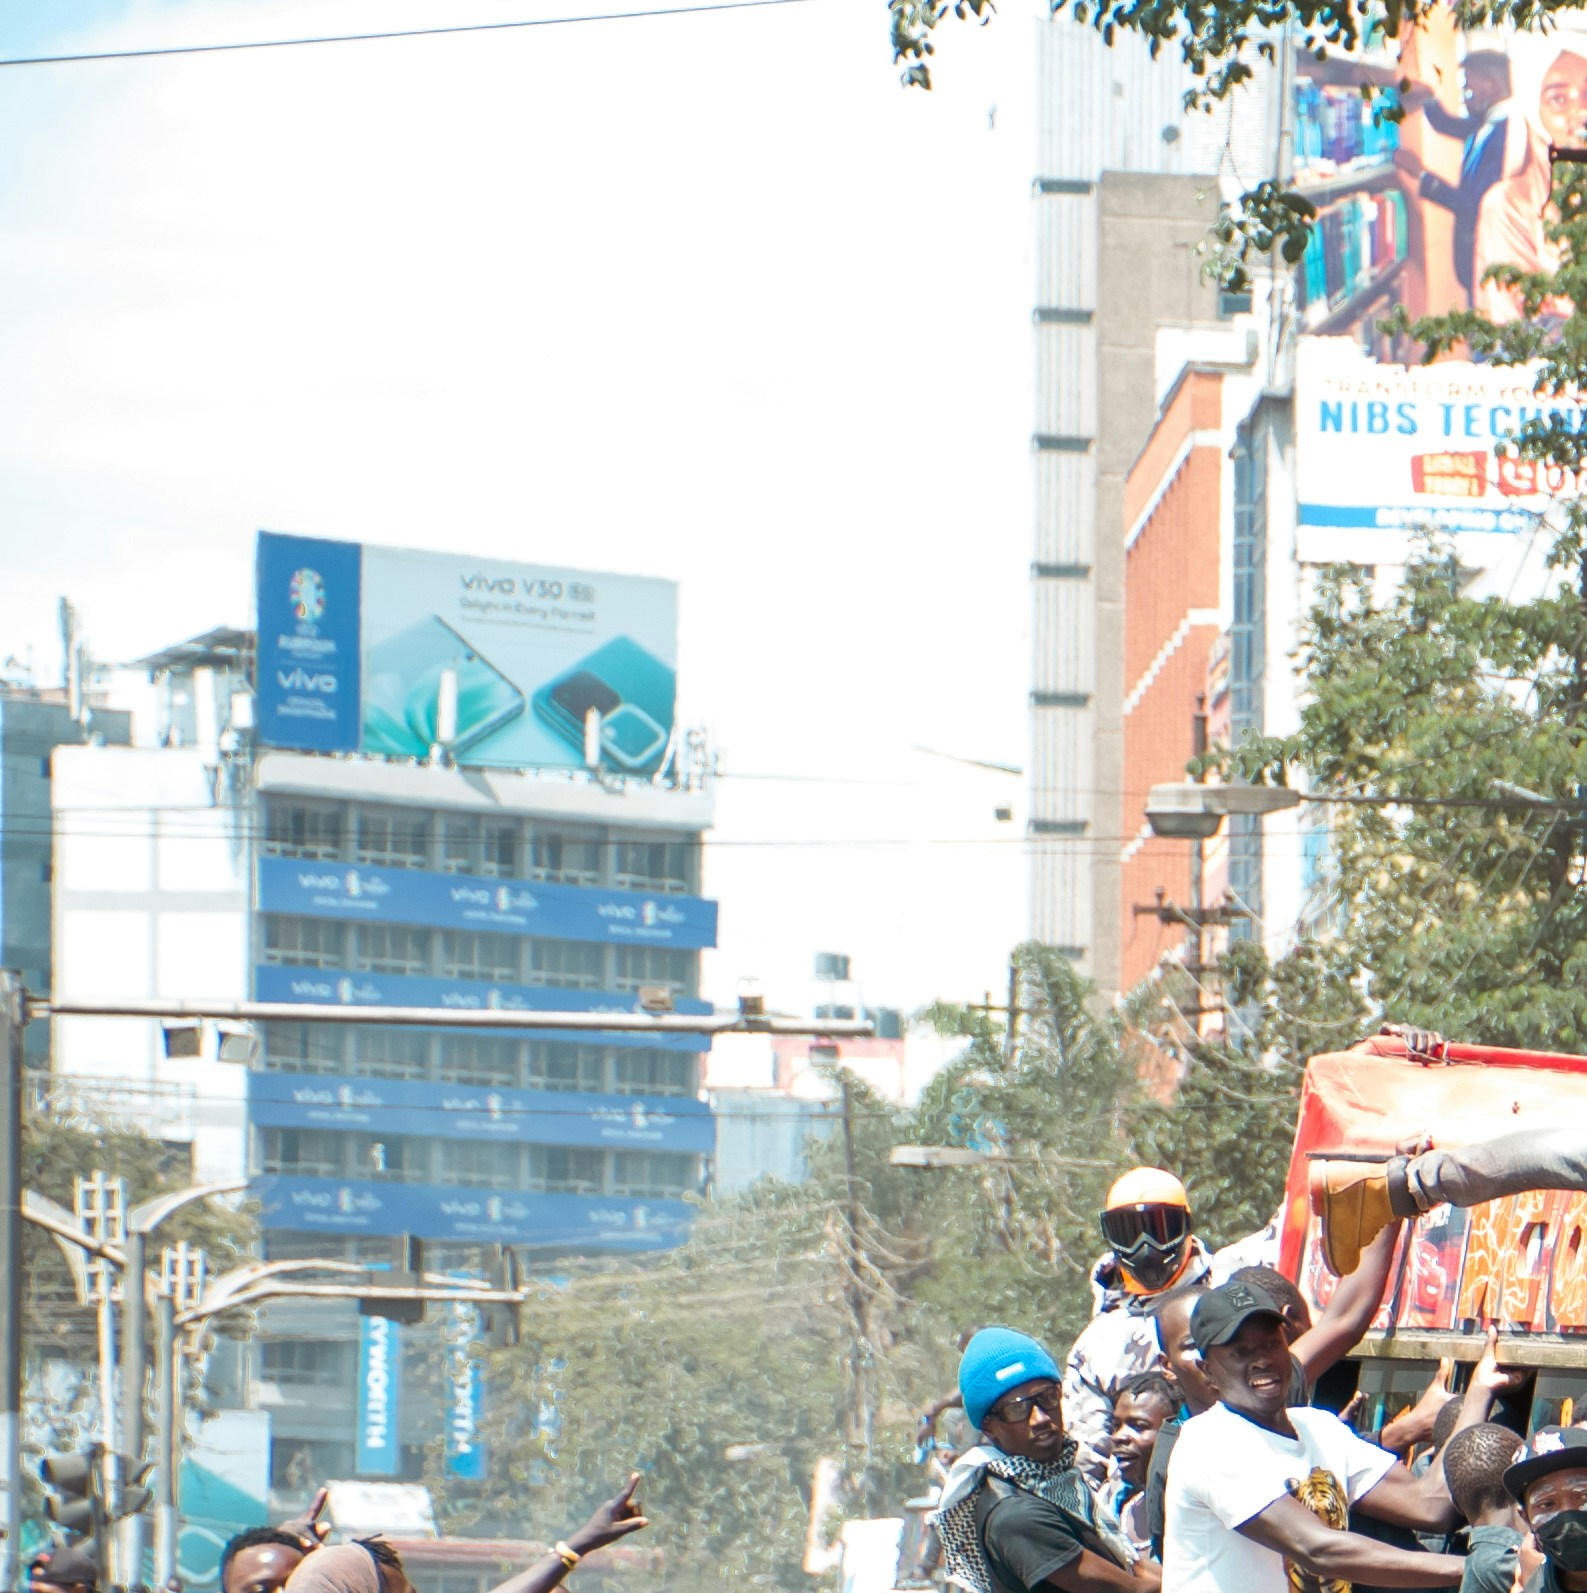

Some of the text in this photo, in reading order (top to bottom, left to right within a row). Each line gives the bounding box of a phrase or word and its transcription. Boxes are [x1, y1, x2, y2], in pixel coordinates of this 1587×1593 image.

[1319, 401, 1418, 435] NIBS
[460, 571, 516, 596] vivo
[277, 667, 338, 694] vivo
